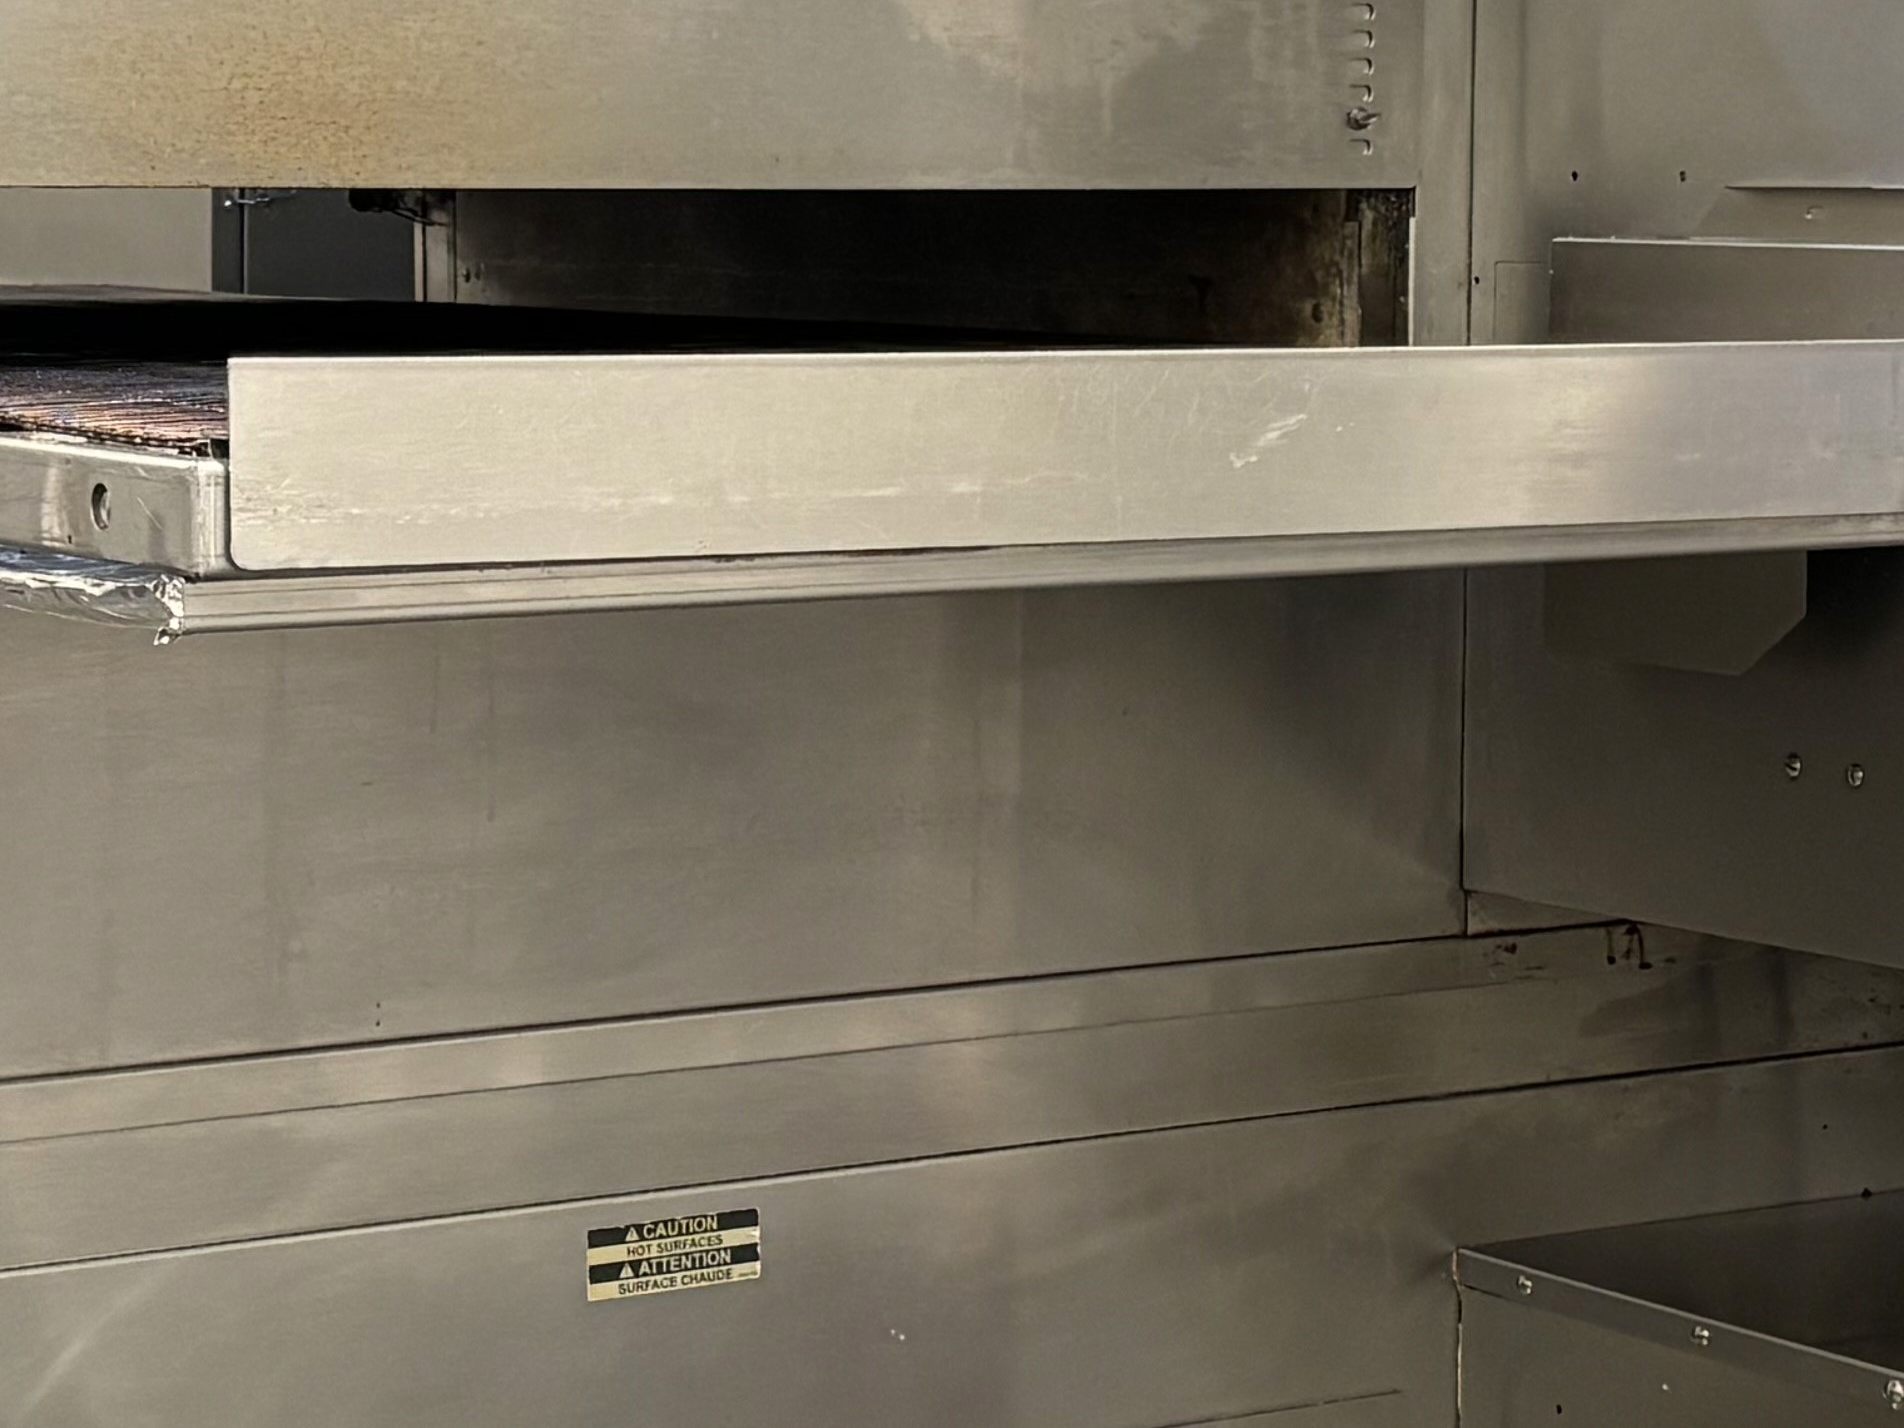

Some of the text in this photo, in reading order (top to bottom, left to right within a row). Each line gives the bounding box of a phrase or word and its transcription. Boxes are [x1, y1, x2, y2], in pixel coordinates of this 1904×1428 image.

[643, 1215, 718, 1240] CAUTION
[627, 1234, 723, 1258] HOT SURFACES
[639, 1249, 731, 1276] ATTENTION
[618, 1268, 733, 1295] SURFACE CHAUDE
